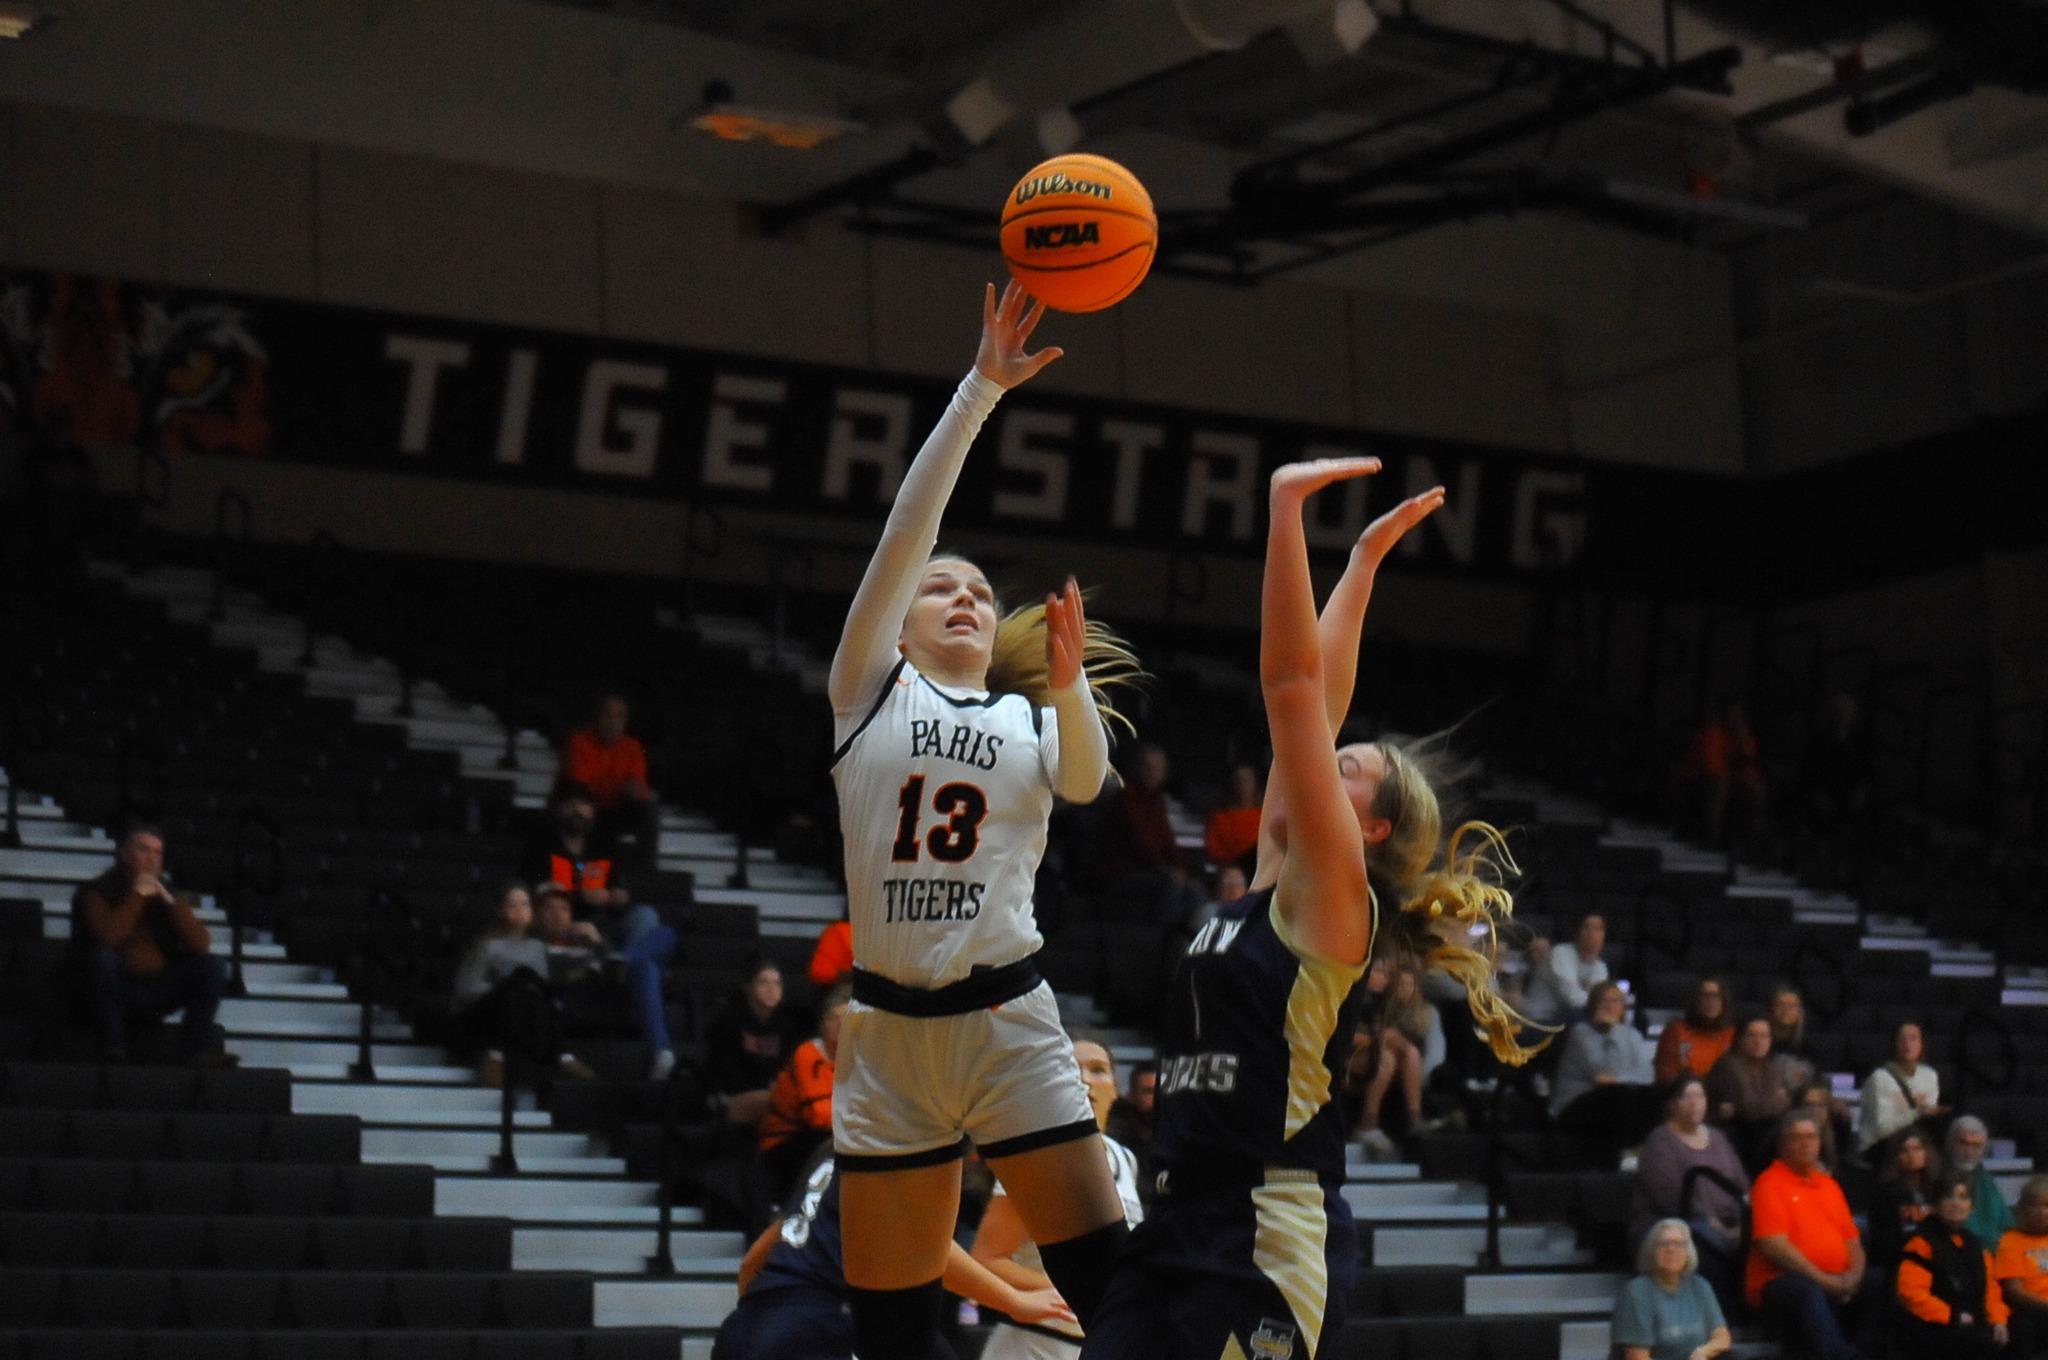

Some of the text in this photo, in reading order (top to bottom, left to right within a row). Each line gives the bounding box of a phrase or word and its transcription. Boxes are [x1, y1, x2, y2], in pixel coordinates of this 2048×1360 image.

[1016, 173, 1112, 205] Wilson
[1025, 222, 1099, 249] NCAA
[383, 333, 1588, 568] TIGER STRONG
[911, 719, 1003, 771] PARIS
[891, 774, 988, 862] 13
[883, 879, 986, 923] TIGERS
